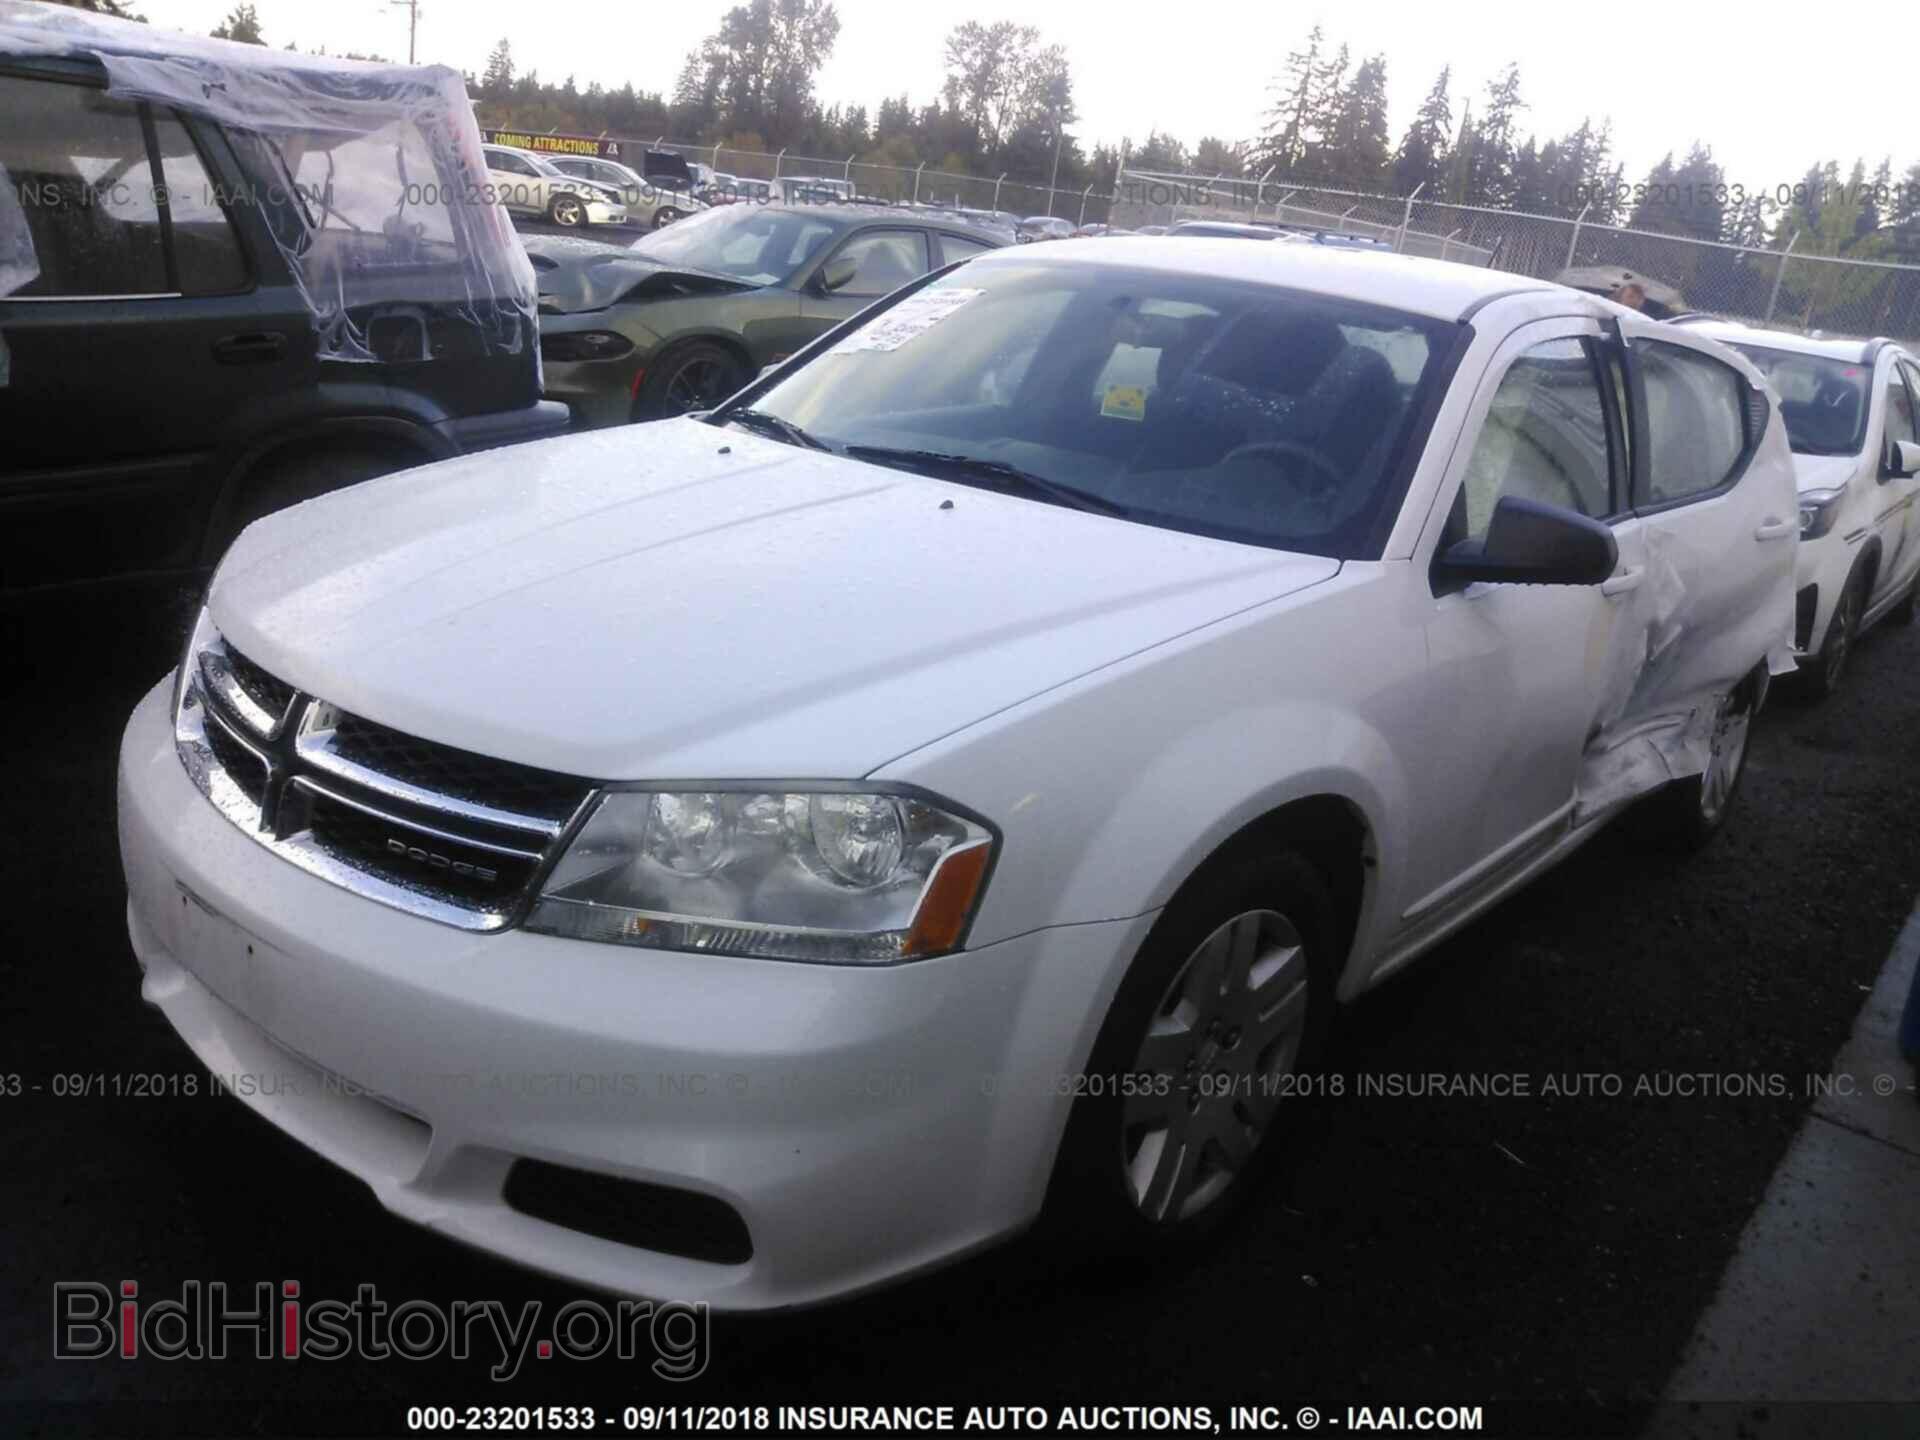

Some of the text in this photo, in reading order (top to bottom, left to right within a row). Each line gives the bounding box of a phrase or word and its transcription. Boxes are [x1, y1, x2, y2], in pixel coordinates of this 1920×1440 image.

[494, 133, 531, 149] COMING
[534, 136, 599, 155] ATTRACTIONS
[386, 838, 498, 880] DODGE
